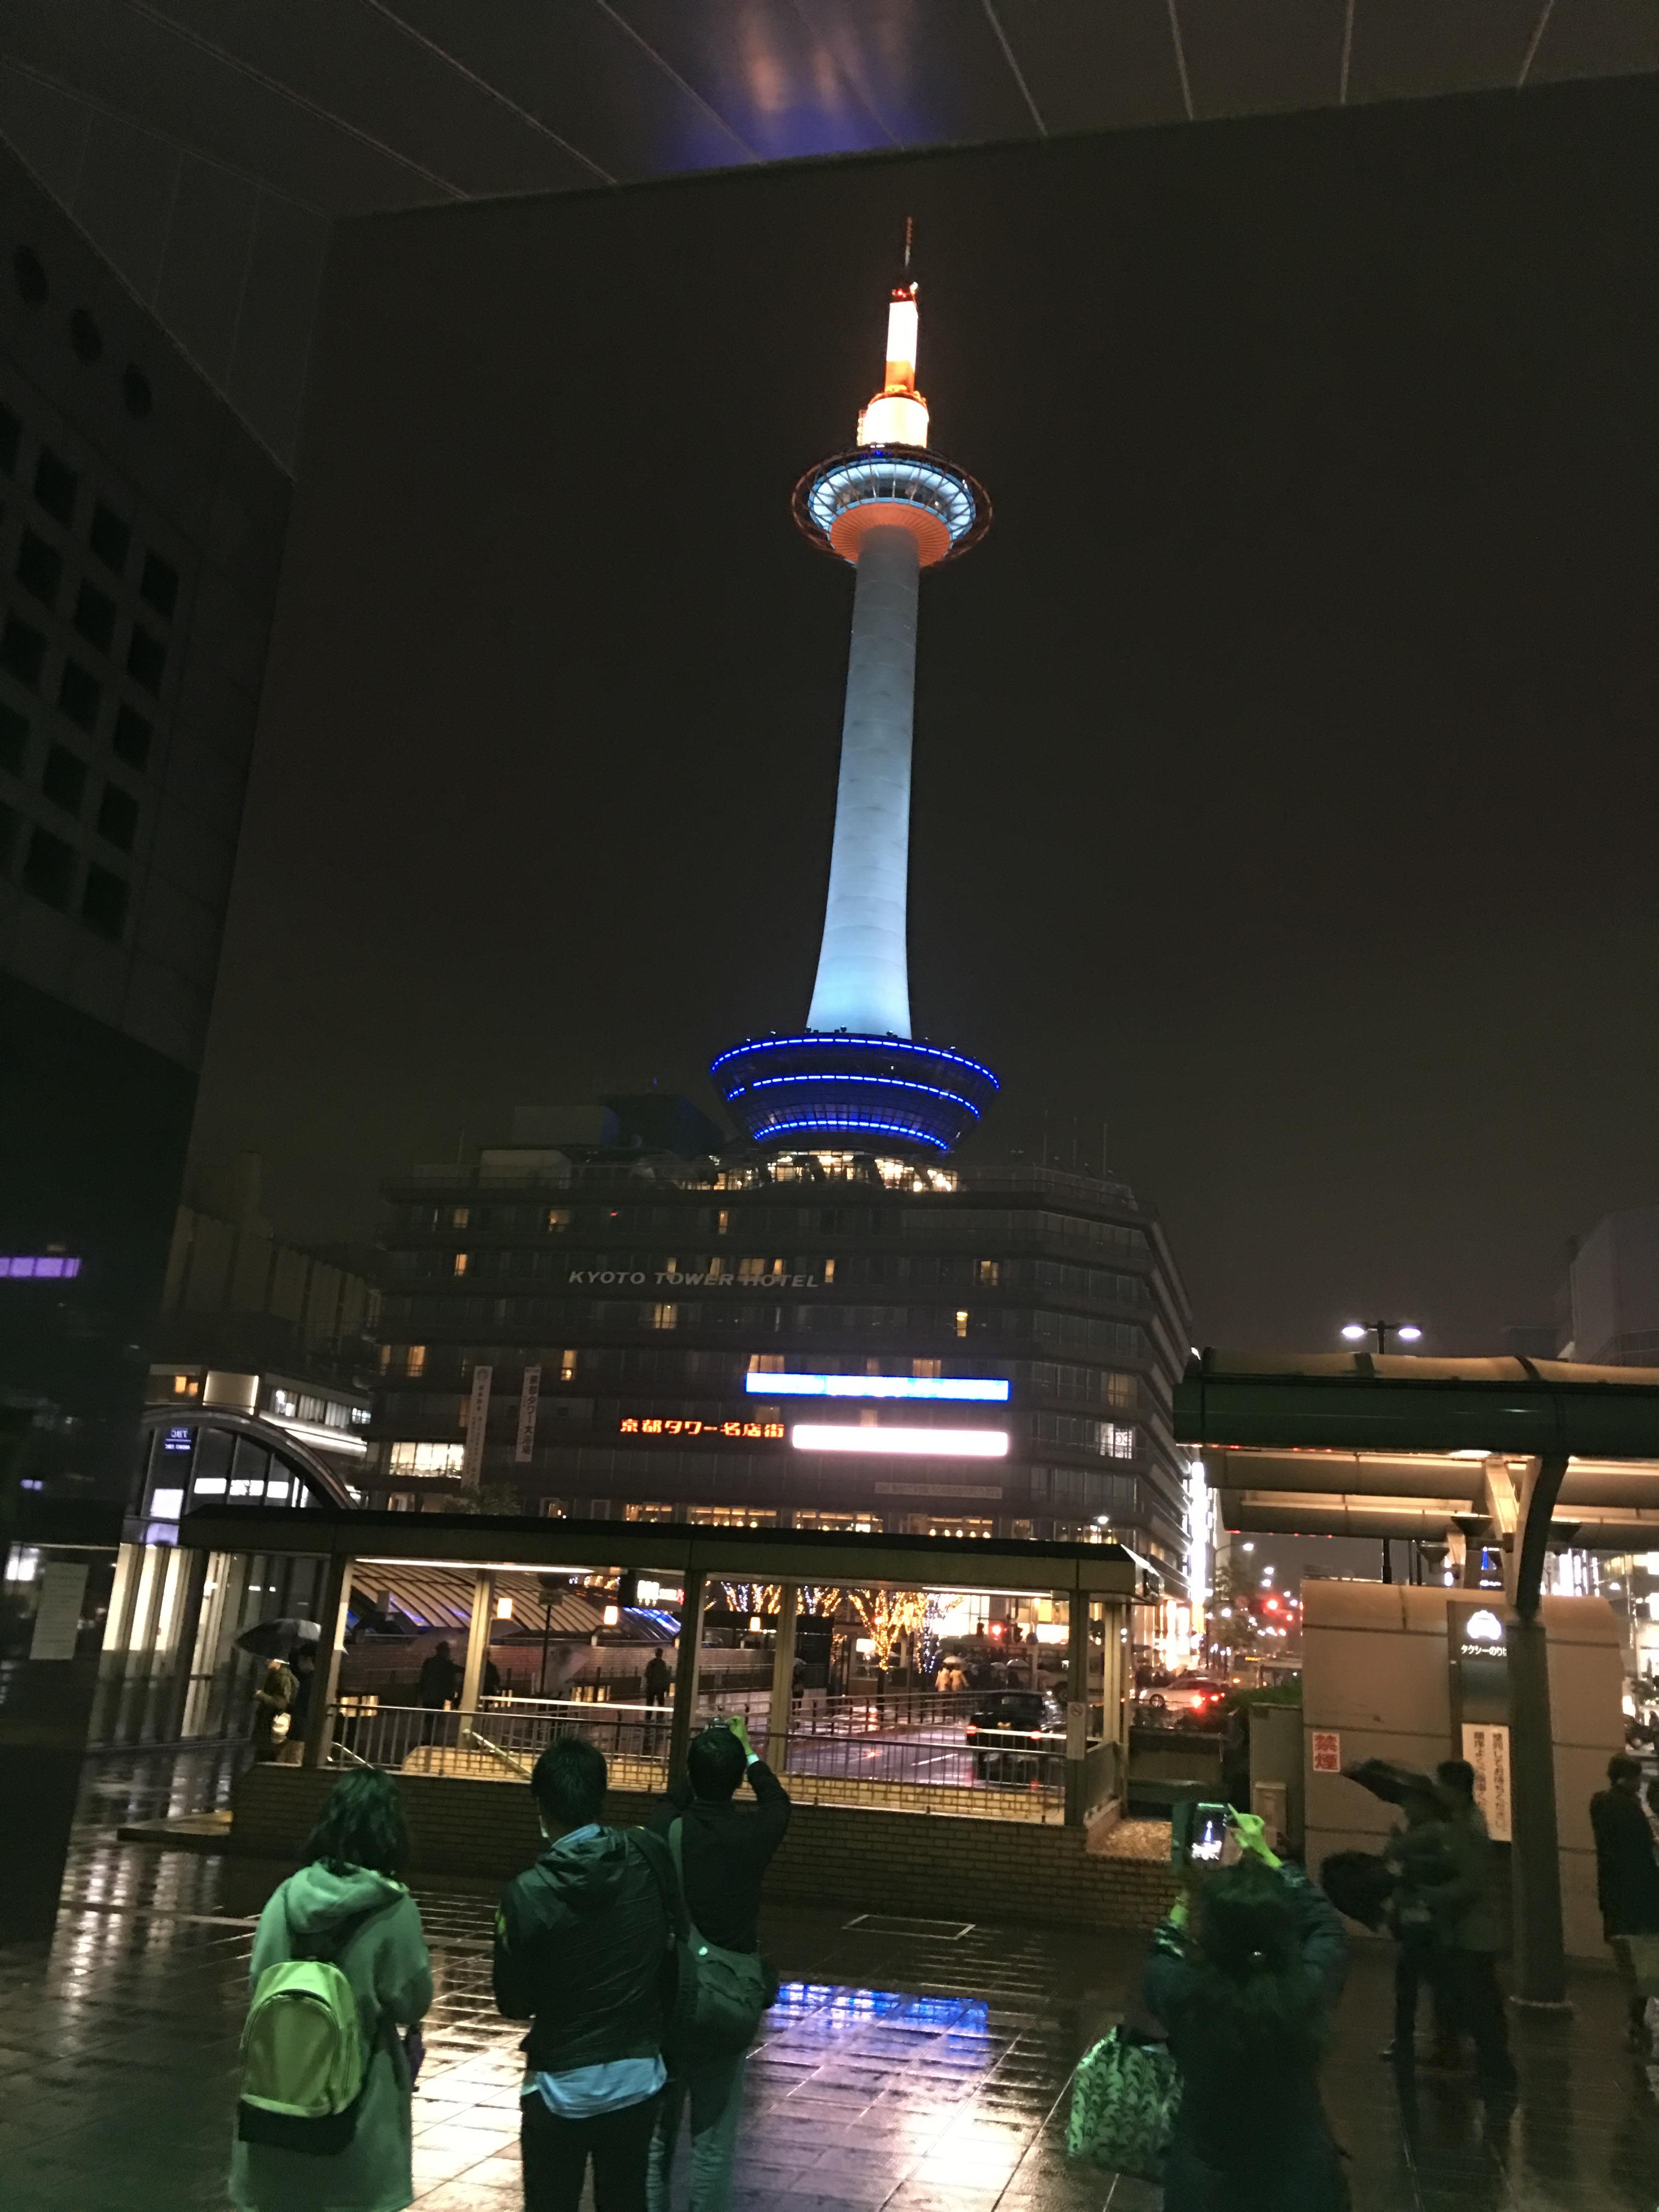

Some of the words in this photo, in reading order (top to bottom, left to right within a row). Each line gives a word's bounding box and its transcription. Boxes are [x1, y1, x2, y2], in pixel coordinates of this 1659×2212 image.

[569, 1271, 645, 1284] KYOTO
[655, 1273, 733, 1286] TOWER
[741, 1274, 819, 1288] HOTEL
[620, 1418, 785, 1438] 京都タワー名店街
[1314, 1735, 1339, 1770] 禁煙
